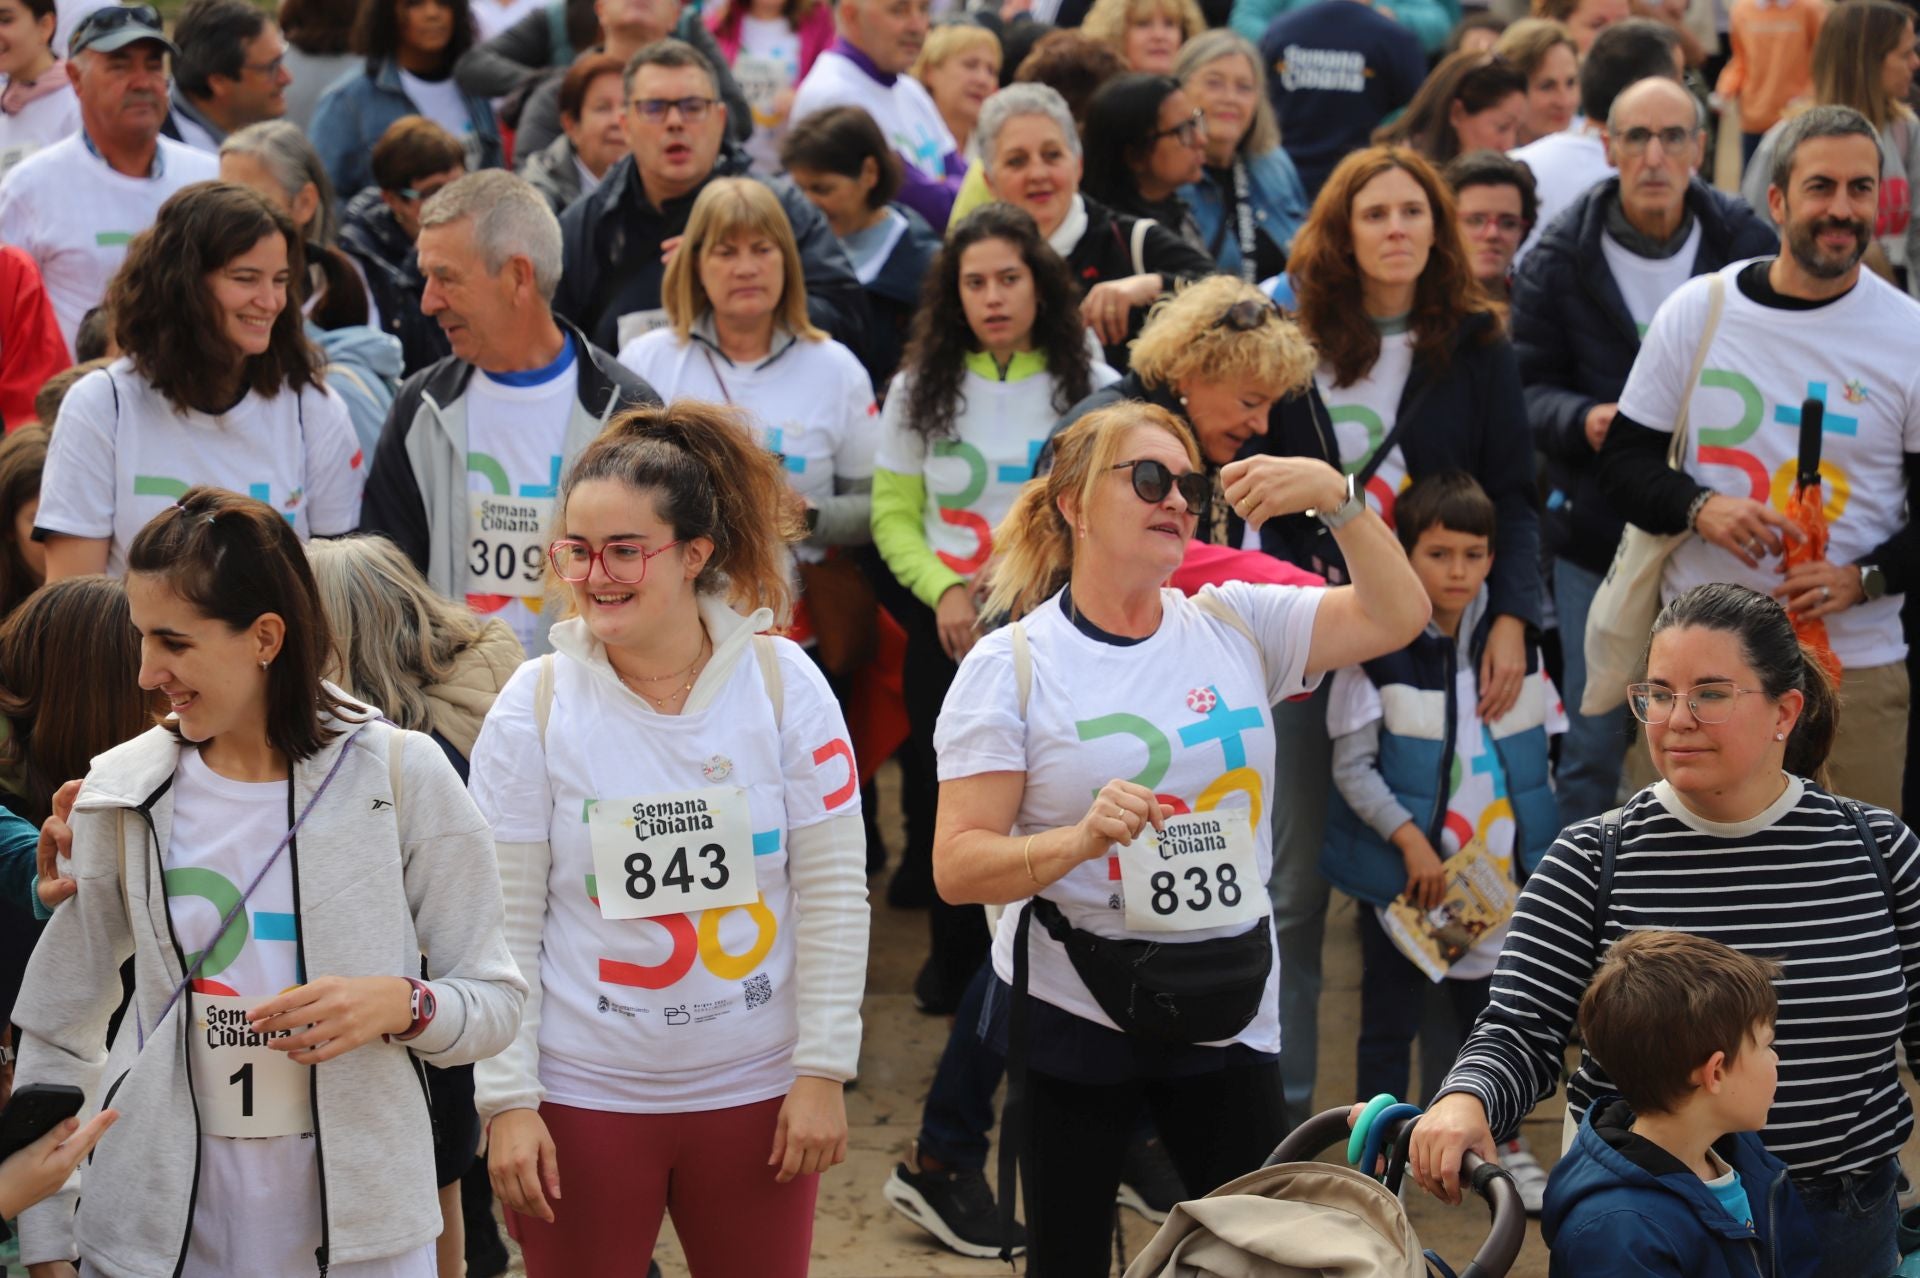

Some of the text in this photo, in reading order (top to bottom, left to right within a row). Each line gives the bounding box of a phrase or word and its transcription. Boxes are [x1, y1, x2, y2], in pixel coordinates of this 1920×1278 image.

[481, 500, 537, 518] Semana
[480, 514, 539, 533] Cidiana
[470, 538, 546, 582] 309
[633, 799, 708, 822] Semana
[635, 814, 714, 842] Cidiana
[1156, 820, 1221, 842] Semana
[1158, 834, 1226, 861] Cidiana
[624, 843, 730, 900] 843
[1150, 862, 1242, 916] 838
[206, 1004, 252, 1026] Sem
[230, 1063, 253, 1117] 1
